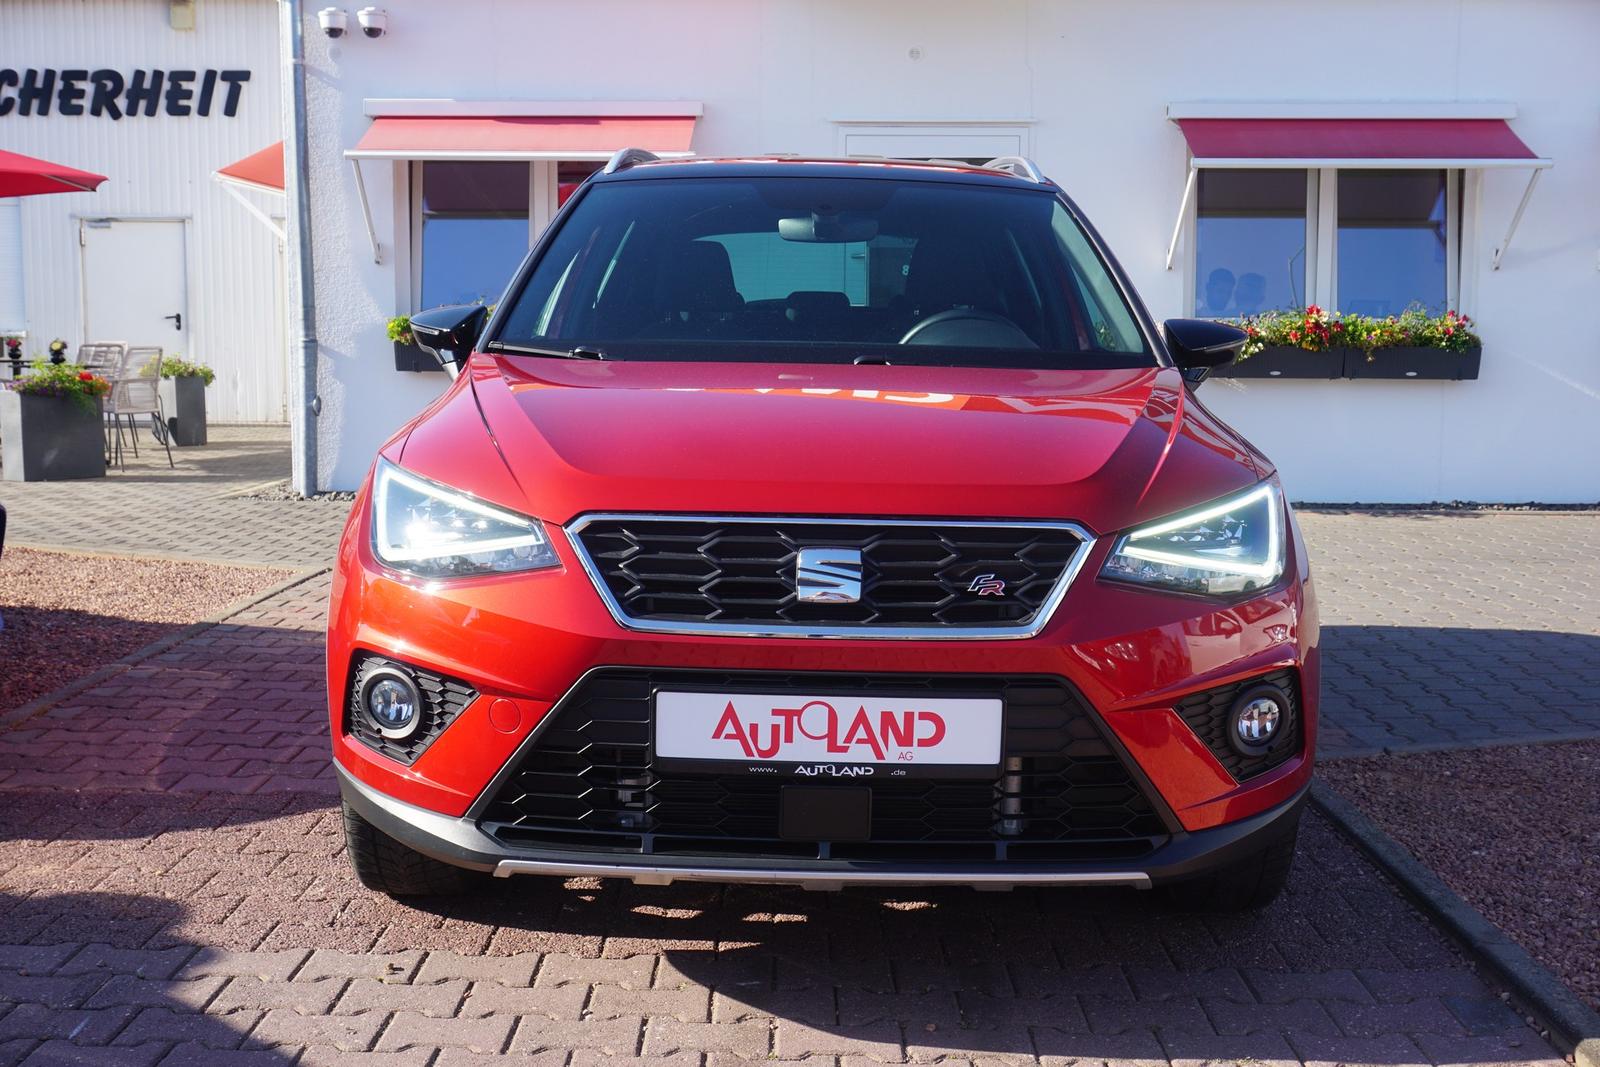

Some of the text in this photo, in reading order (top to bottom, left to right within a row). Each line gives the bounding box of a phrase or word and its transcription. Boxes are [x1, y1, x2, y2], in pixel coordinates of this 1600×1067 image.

[967, 573, 1005, 596] FR
[711, 700, 946, 760] AUTOLAND
[897, 751, 914, 761] AG
[794, 764, 875, 777] AUTOLAND
[890, 768, 906, 776] .de
